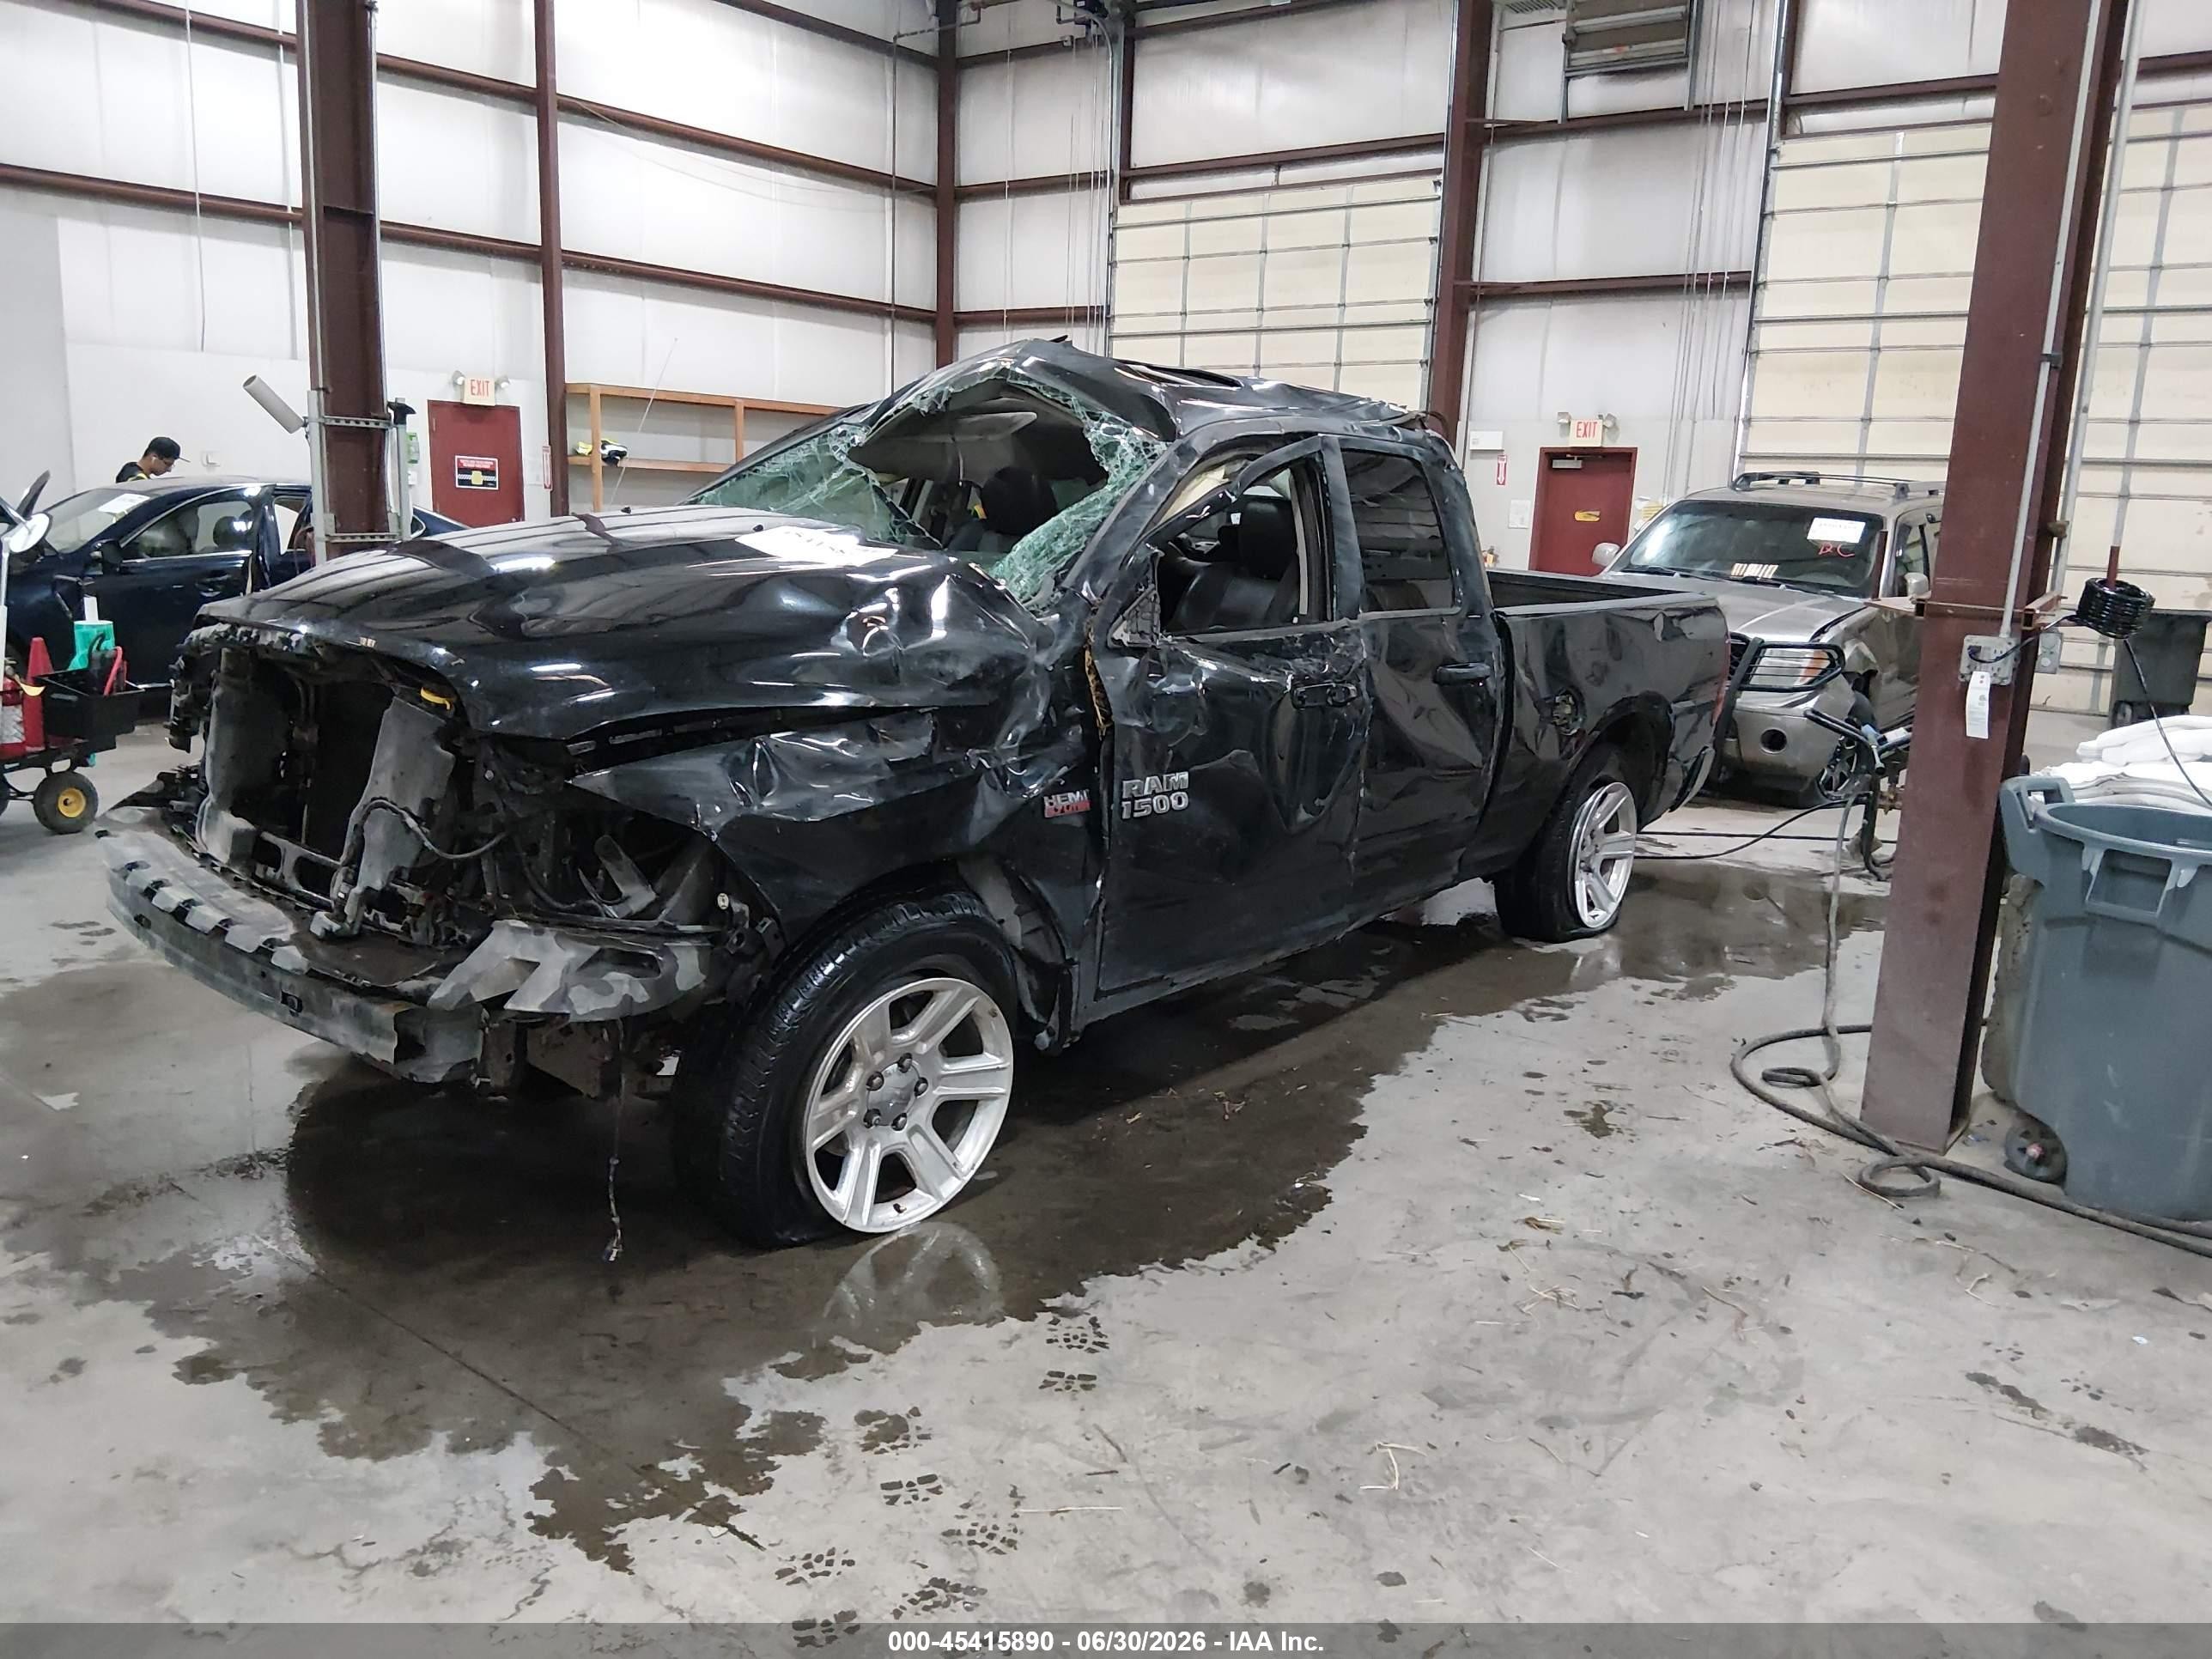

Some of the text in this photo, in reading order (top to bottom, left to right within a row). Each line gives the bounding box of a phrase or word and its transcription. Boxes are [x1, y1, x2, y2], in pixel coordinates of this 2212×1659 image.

[471, 380, 489, 398] EXIT
[1576, 421, 1598, 439] EXIT
[1122, 771, 1188, 799] RAM
[1043, 788, 1090, 806] HEMI
[1121, 792, 1188, 818] 1500
